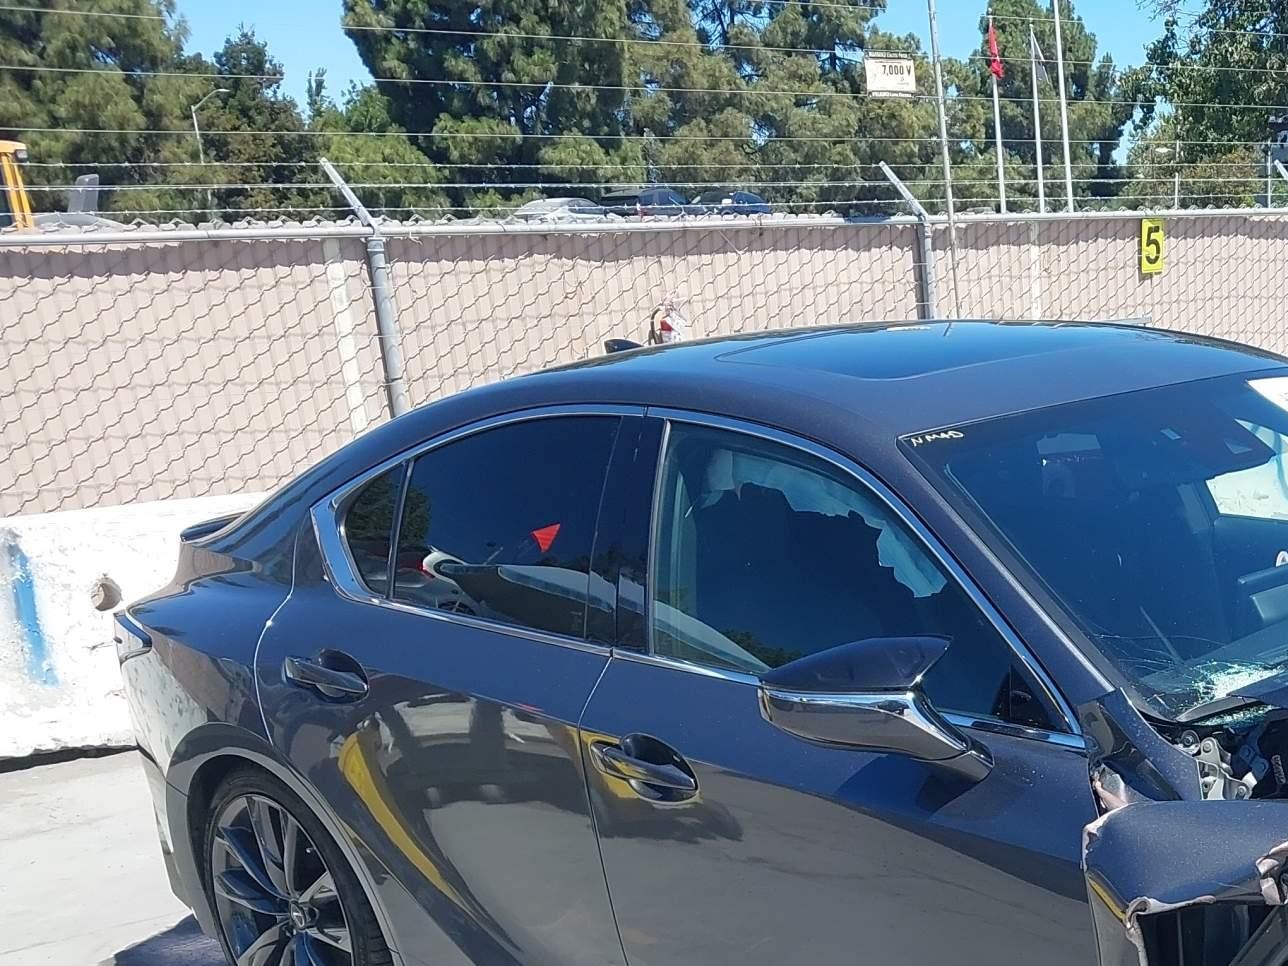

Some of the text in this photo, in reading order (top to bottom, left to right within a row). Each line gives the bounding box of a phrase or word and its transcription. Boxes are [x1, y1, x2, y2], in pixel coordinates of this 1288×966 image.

[881, 64, 912, 77] 7,000 V
[1145, 225, 1161, 265] 5
